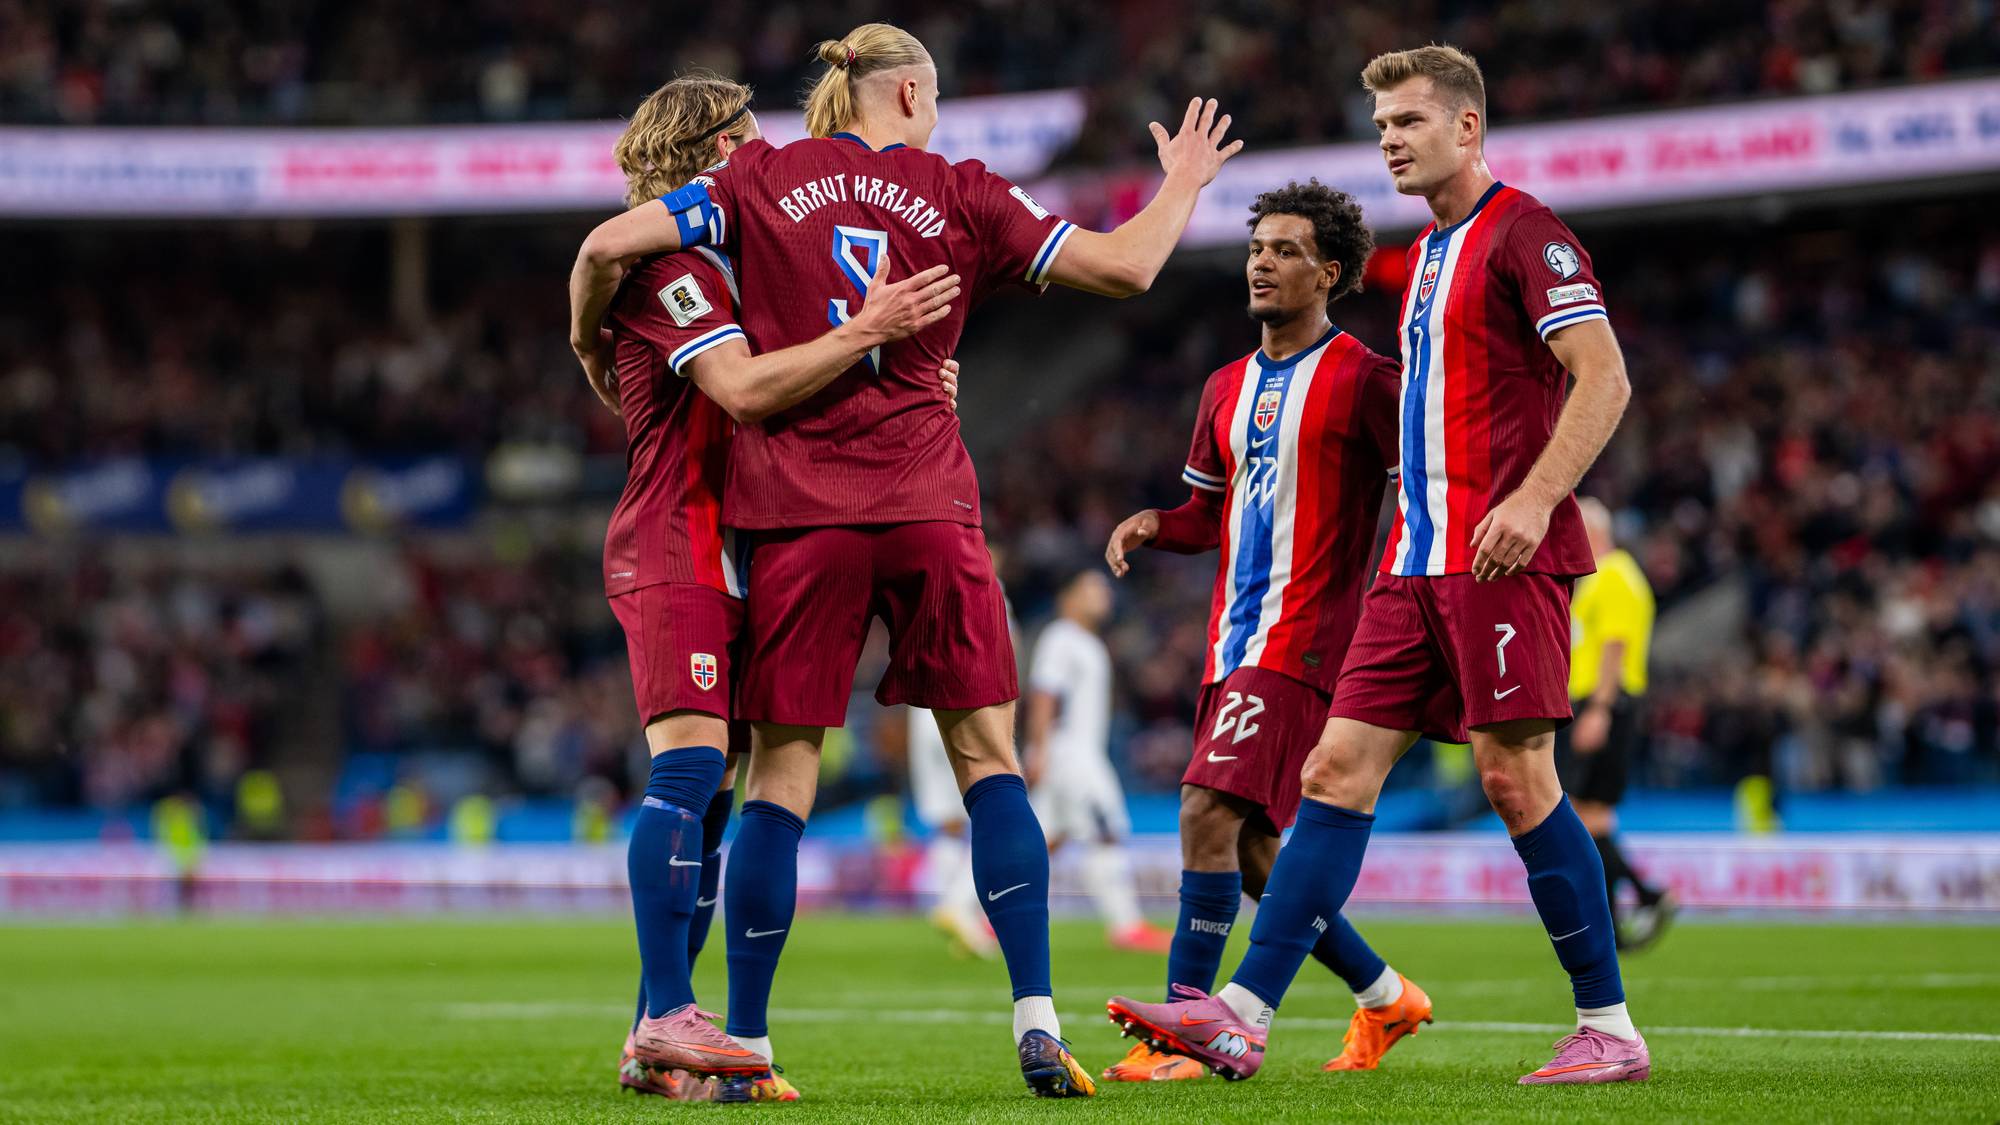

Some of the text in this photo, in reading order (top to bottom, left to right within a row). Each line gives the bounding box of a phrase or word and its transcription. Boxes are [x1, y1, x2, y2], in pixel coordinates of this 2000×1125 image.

[778, 173, 947, 239] BRAUT HAALAND
[828, 225, 888, 377] 9
[1243, 456, 1279, 510] 22
[1494, 623, 1517, 679] 7
[1211, 691, 1266, 745] 22
[1191, 917, 1232, 936] NORGE
